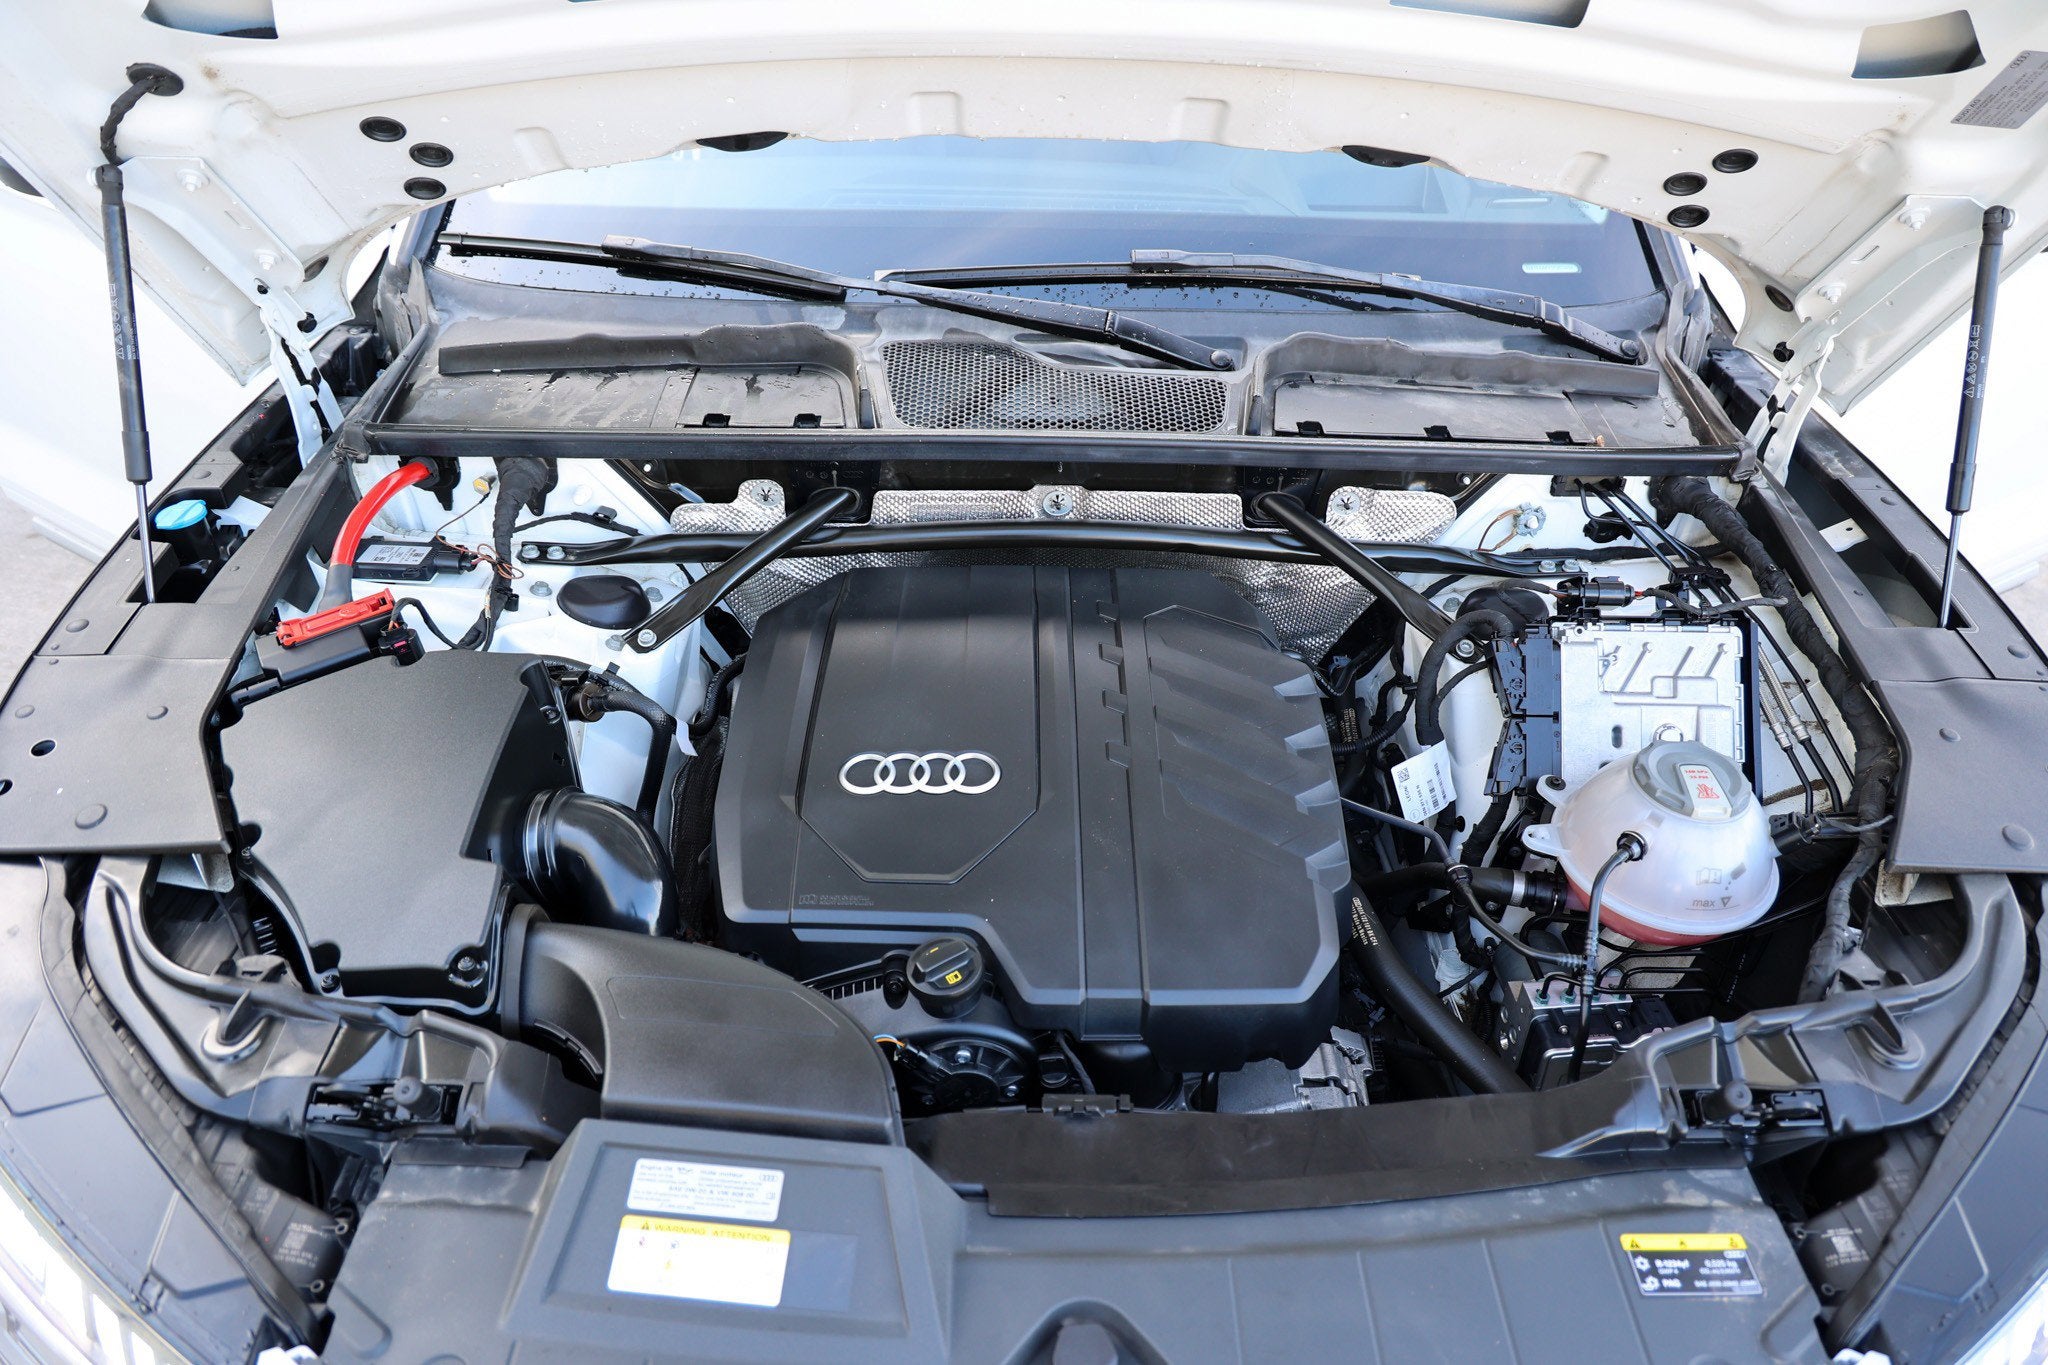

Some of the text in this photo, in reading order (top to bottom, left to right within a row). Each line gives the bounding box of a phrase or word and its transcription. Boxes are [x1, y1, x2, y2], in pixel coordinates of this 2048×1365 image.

[1692, 898, 1715, 907] max
[654, 1223, 772, 1242] WARNING ATTENTION
